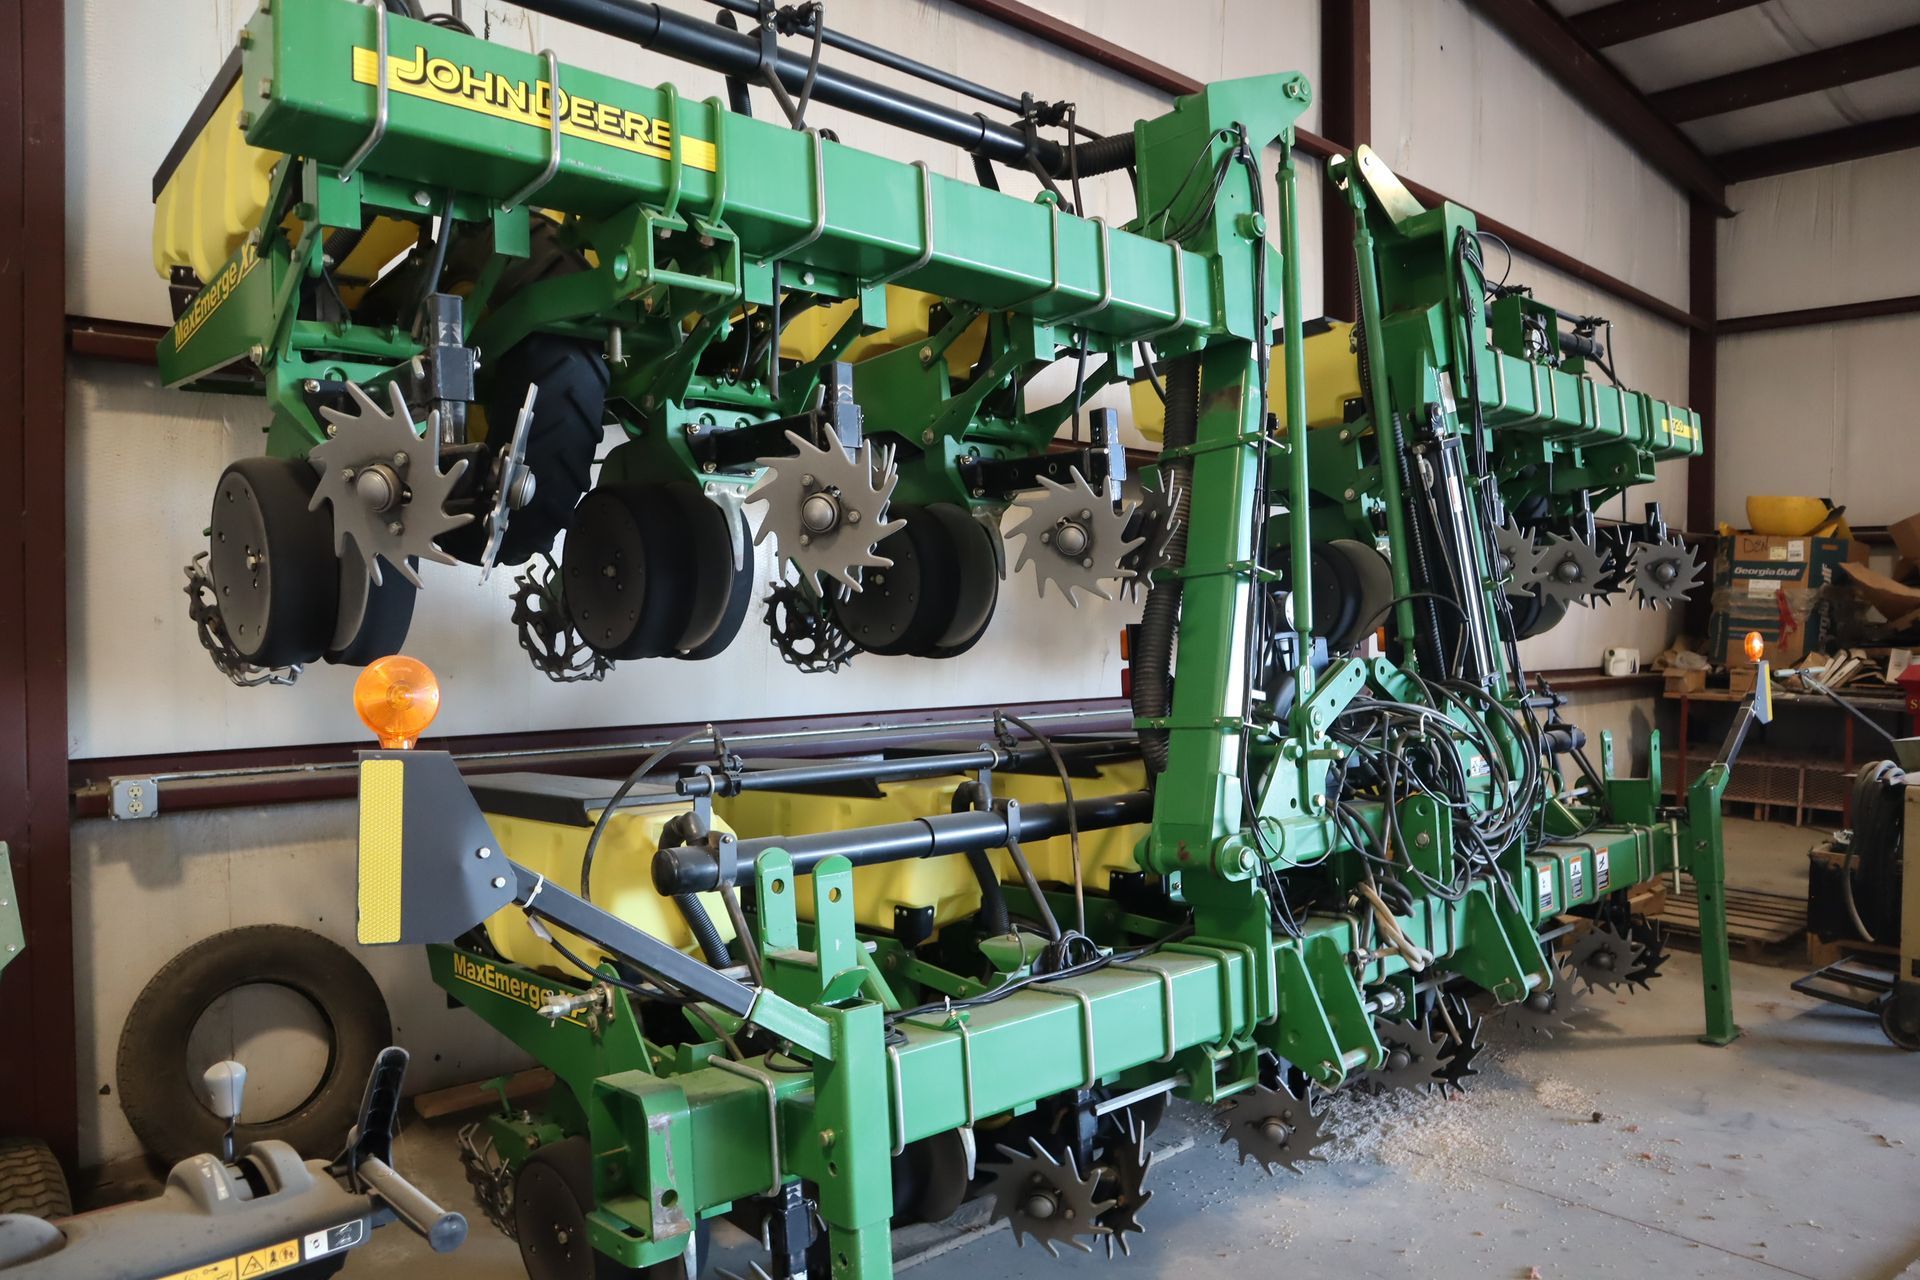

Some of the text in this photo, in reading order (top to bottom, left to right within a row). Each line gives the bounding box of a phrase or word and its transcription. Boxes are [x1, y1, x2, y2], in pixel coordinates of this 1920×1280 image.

[397, 45, 670, 149] JOHN DEERE
[174, 261, 238, 350] MaxEmerge
[1734, 566, 1800, 577] Georgia Gulf
